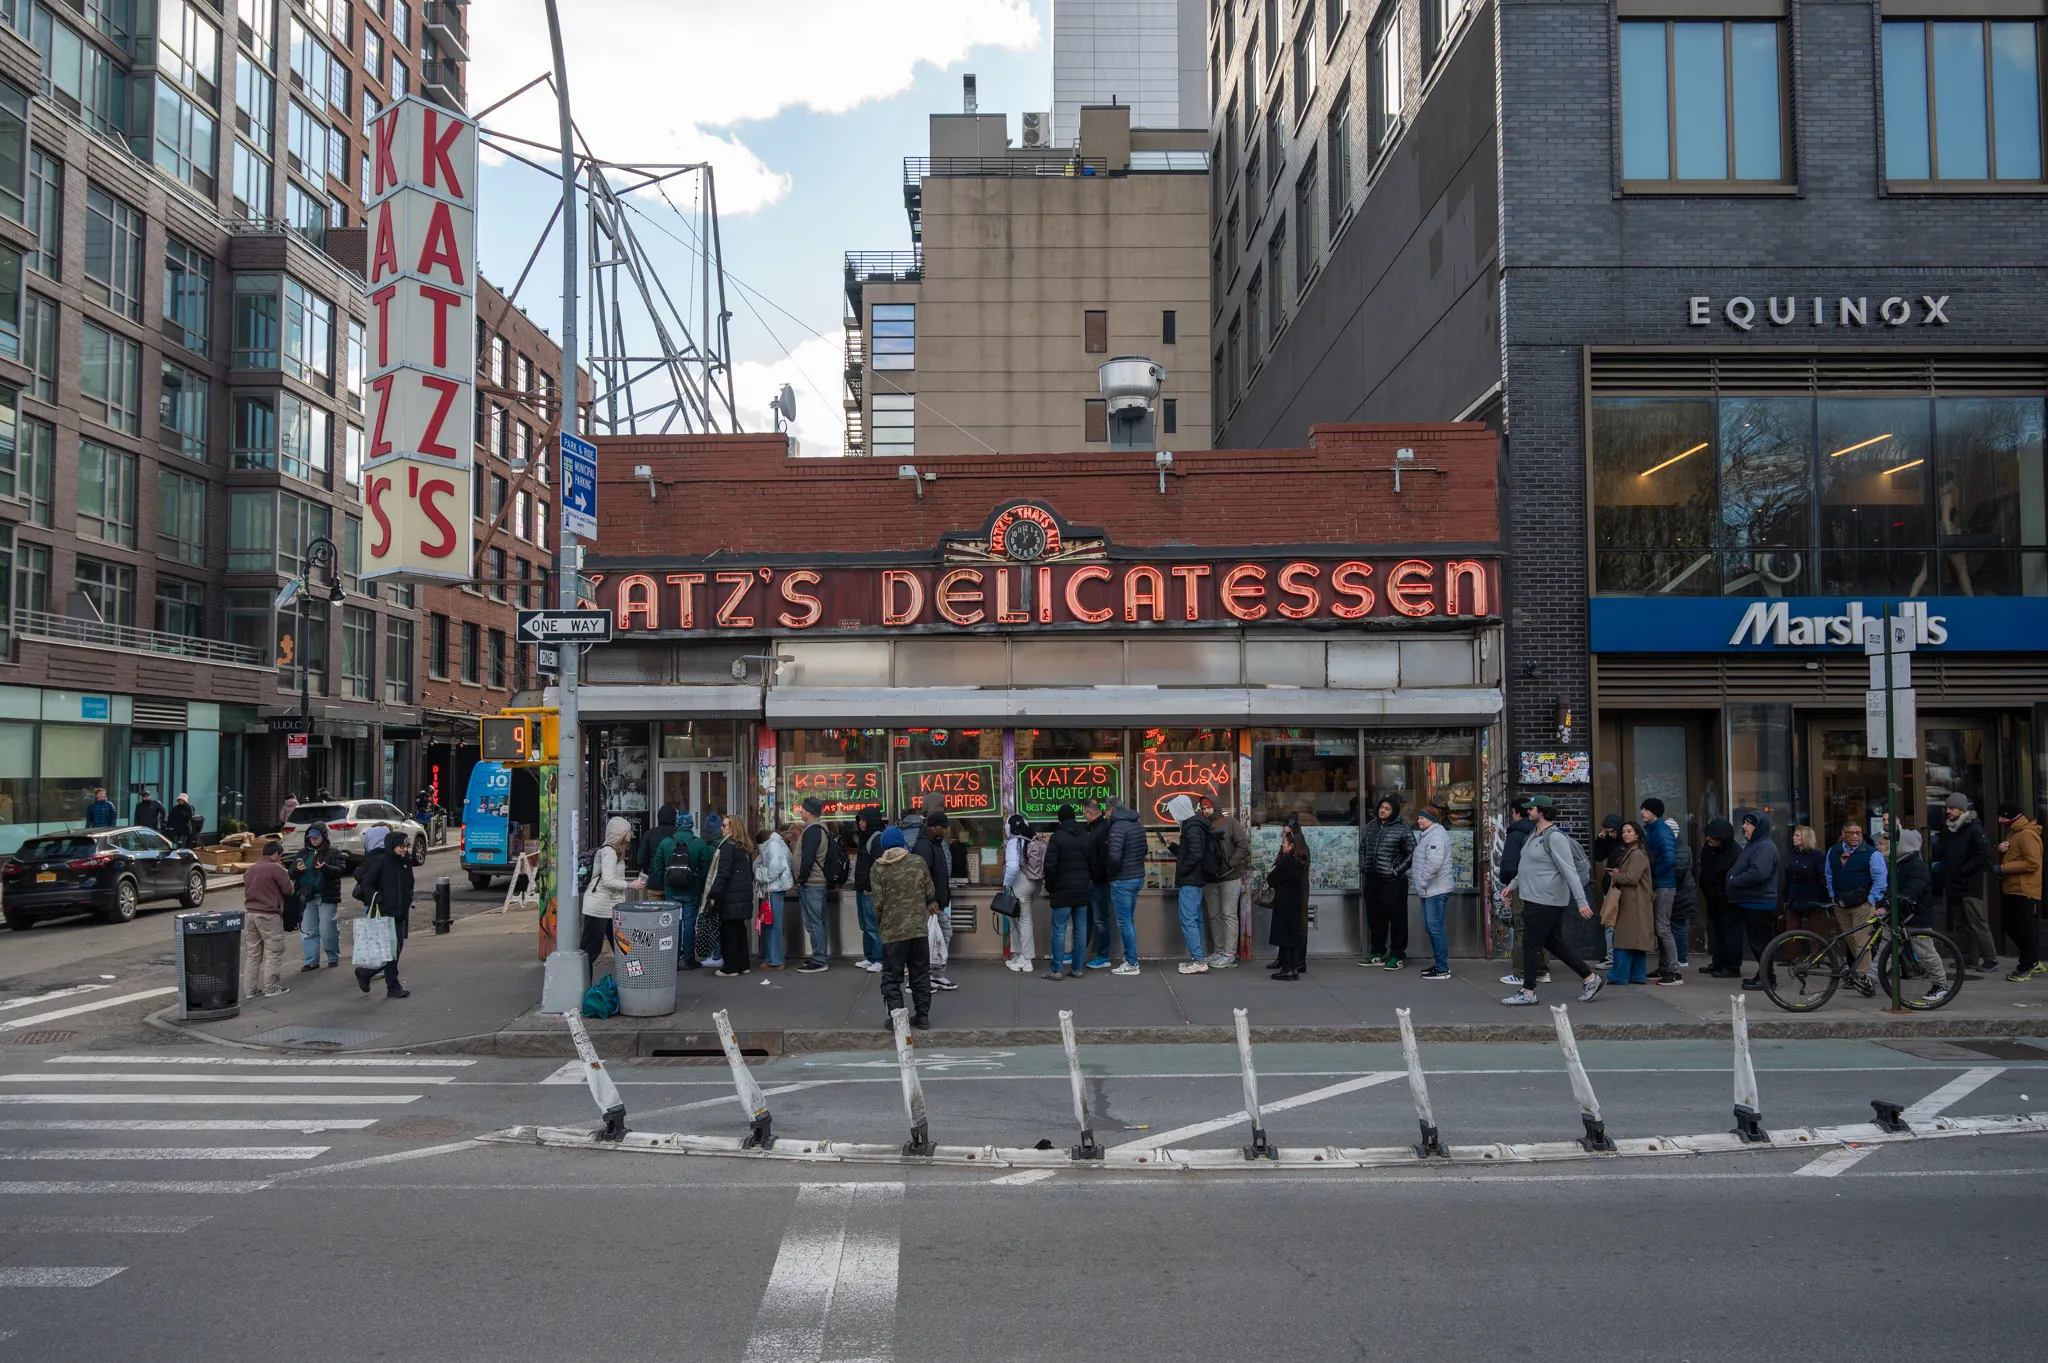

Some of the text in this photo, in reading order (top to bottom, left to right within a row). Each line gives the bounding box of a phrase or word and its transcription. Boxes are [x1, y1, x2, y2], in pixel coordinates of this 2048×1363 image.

[1690, 295, 1950, 330] EQUINOX
[366, 107, 399, 559] KATZ'S
[408, 108, 465, 559] KATZ'S
[564, 438, 577, 452] PARK
[584, 447, 594, 460] RIDE
[574, 461, 595, 479] MUNICIPAL
[574, 474, 592, 491] PARKING
[882, 559, 1486, 627] DELICATESSEN
[532, 620, 599, 632] ONE WAY
[542, 651, 553, 664] ONE
[513, 727, 525, 754] 9
[920, 771, 980, 792] KATZ'S
[1030, 763, 1107, 787] KATZ'S
[1143, 758, 1229, 796] Katz's
[1029, 786, 1110, 800] DELICATESSEN
[1026, 803, 1044, 812] BEST
[226, 918, 242, 927] NYC
